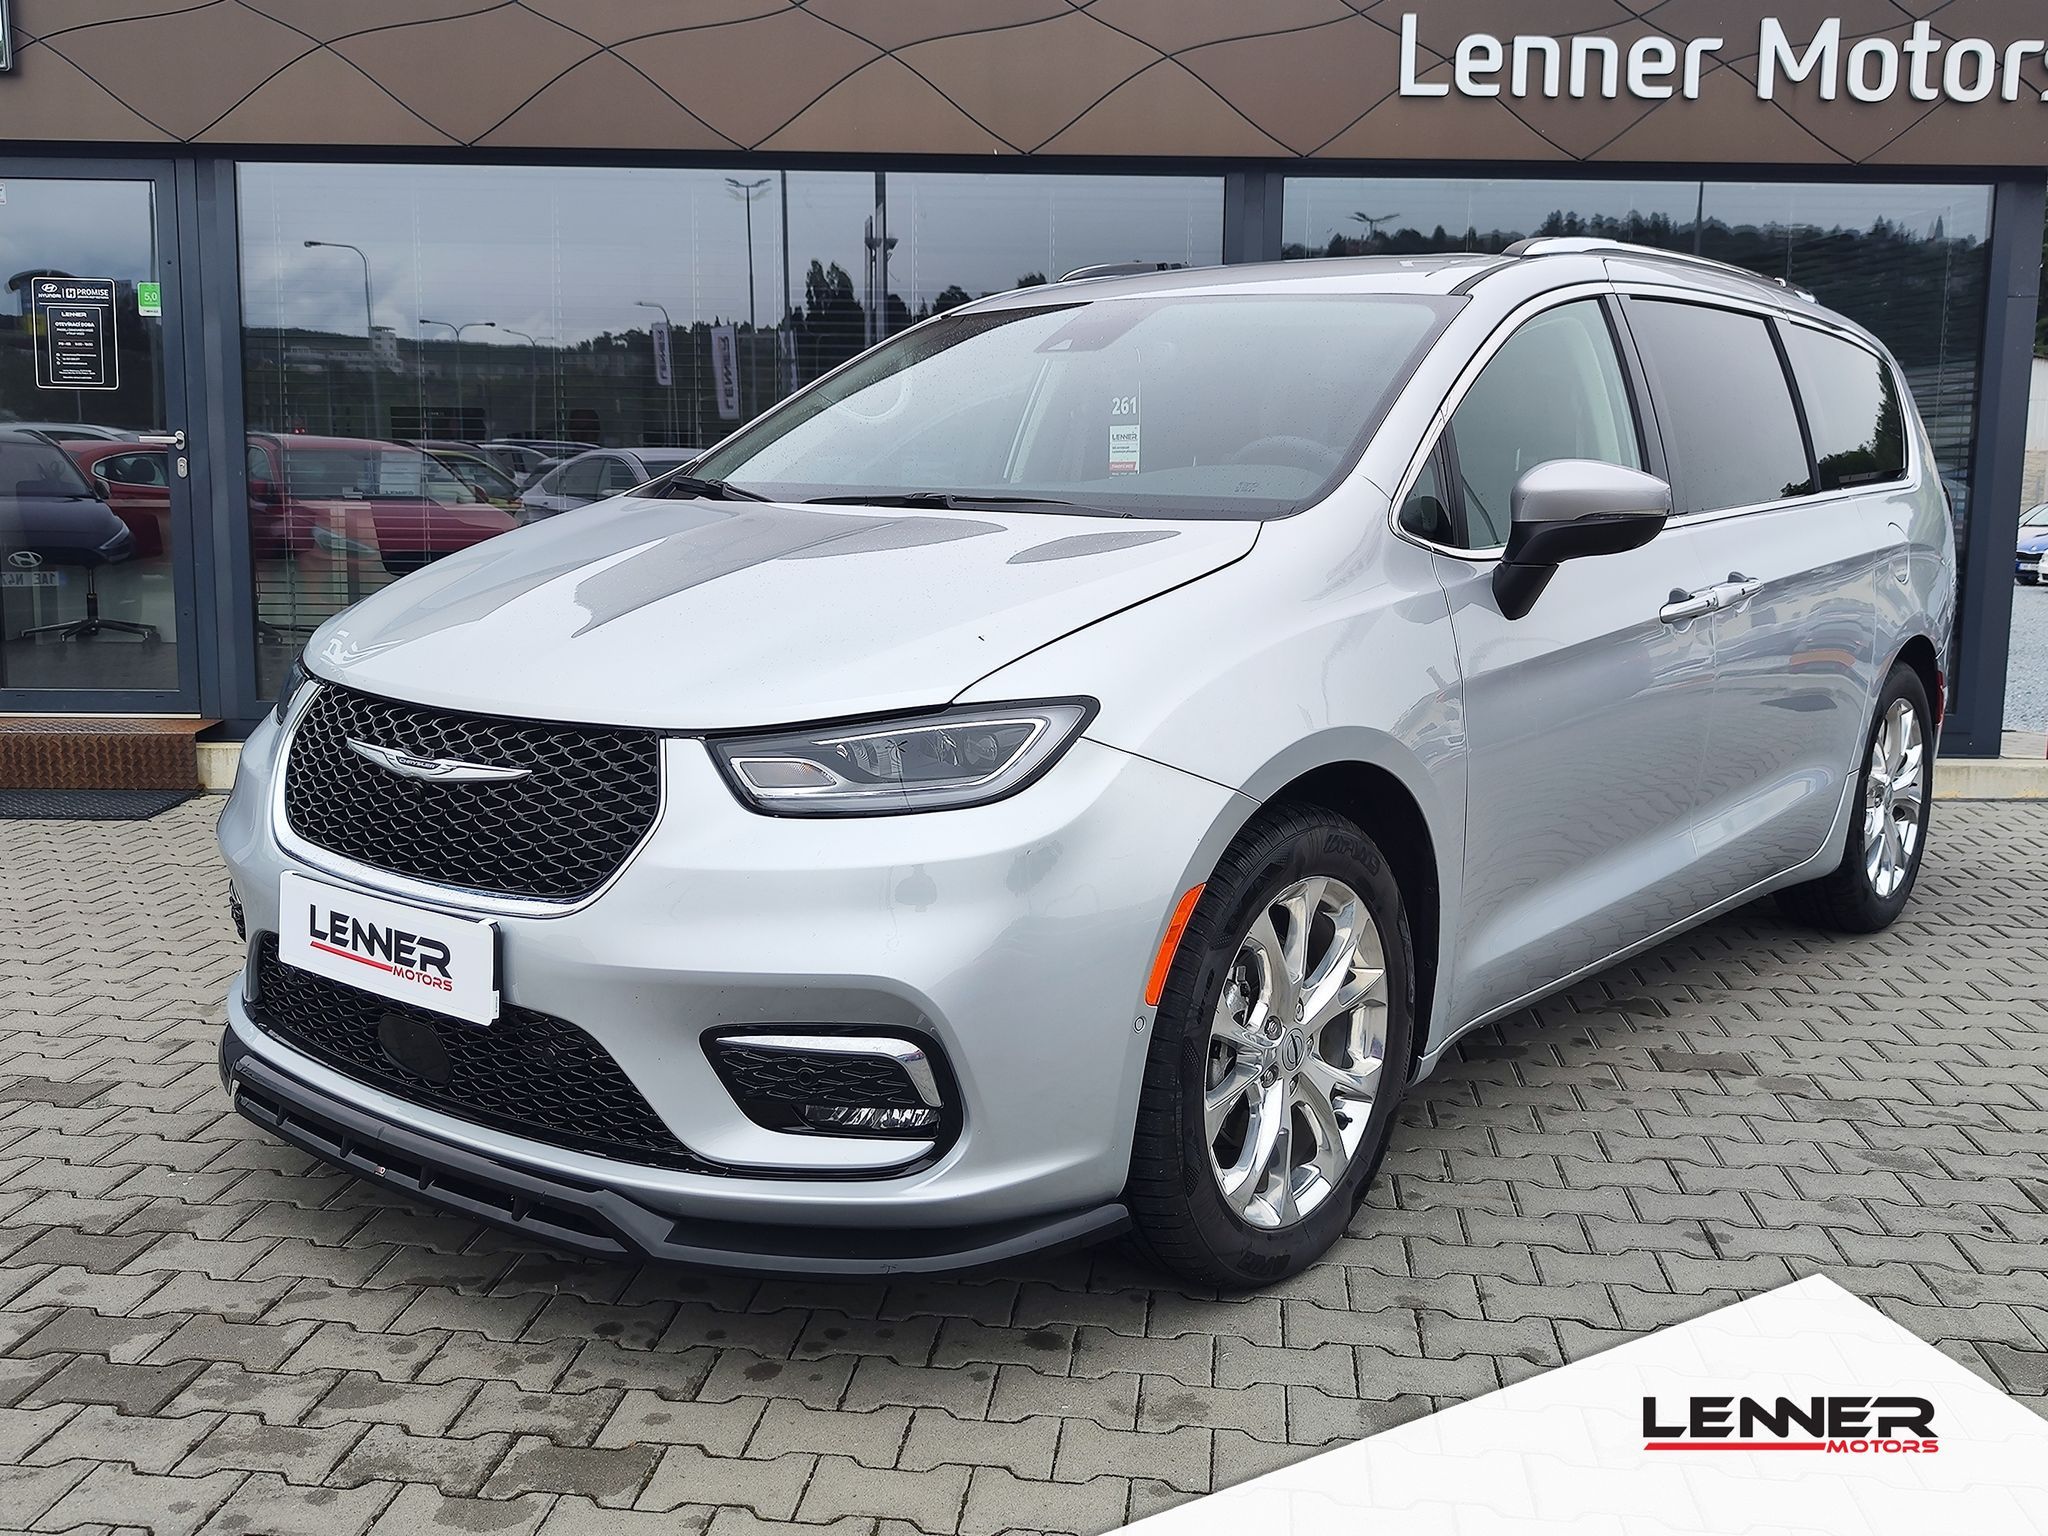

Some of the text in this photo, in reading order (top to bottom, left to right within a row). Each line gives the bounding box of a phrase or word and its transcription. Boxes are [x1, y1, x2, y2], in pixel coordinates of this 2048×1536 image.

[1399, 13, 2048, 104] Lenner Motor
[77, 288, 109, 296] PROMISE
[1112, 397, 1137, 415] 261
[398, 757, 435, 769] CHRYSLER
[310, 903, 453, 980] LENNER
[392, 965, 453, 992] MOTORS
